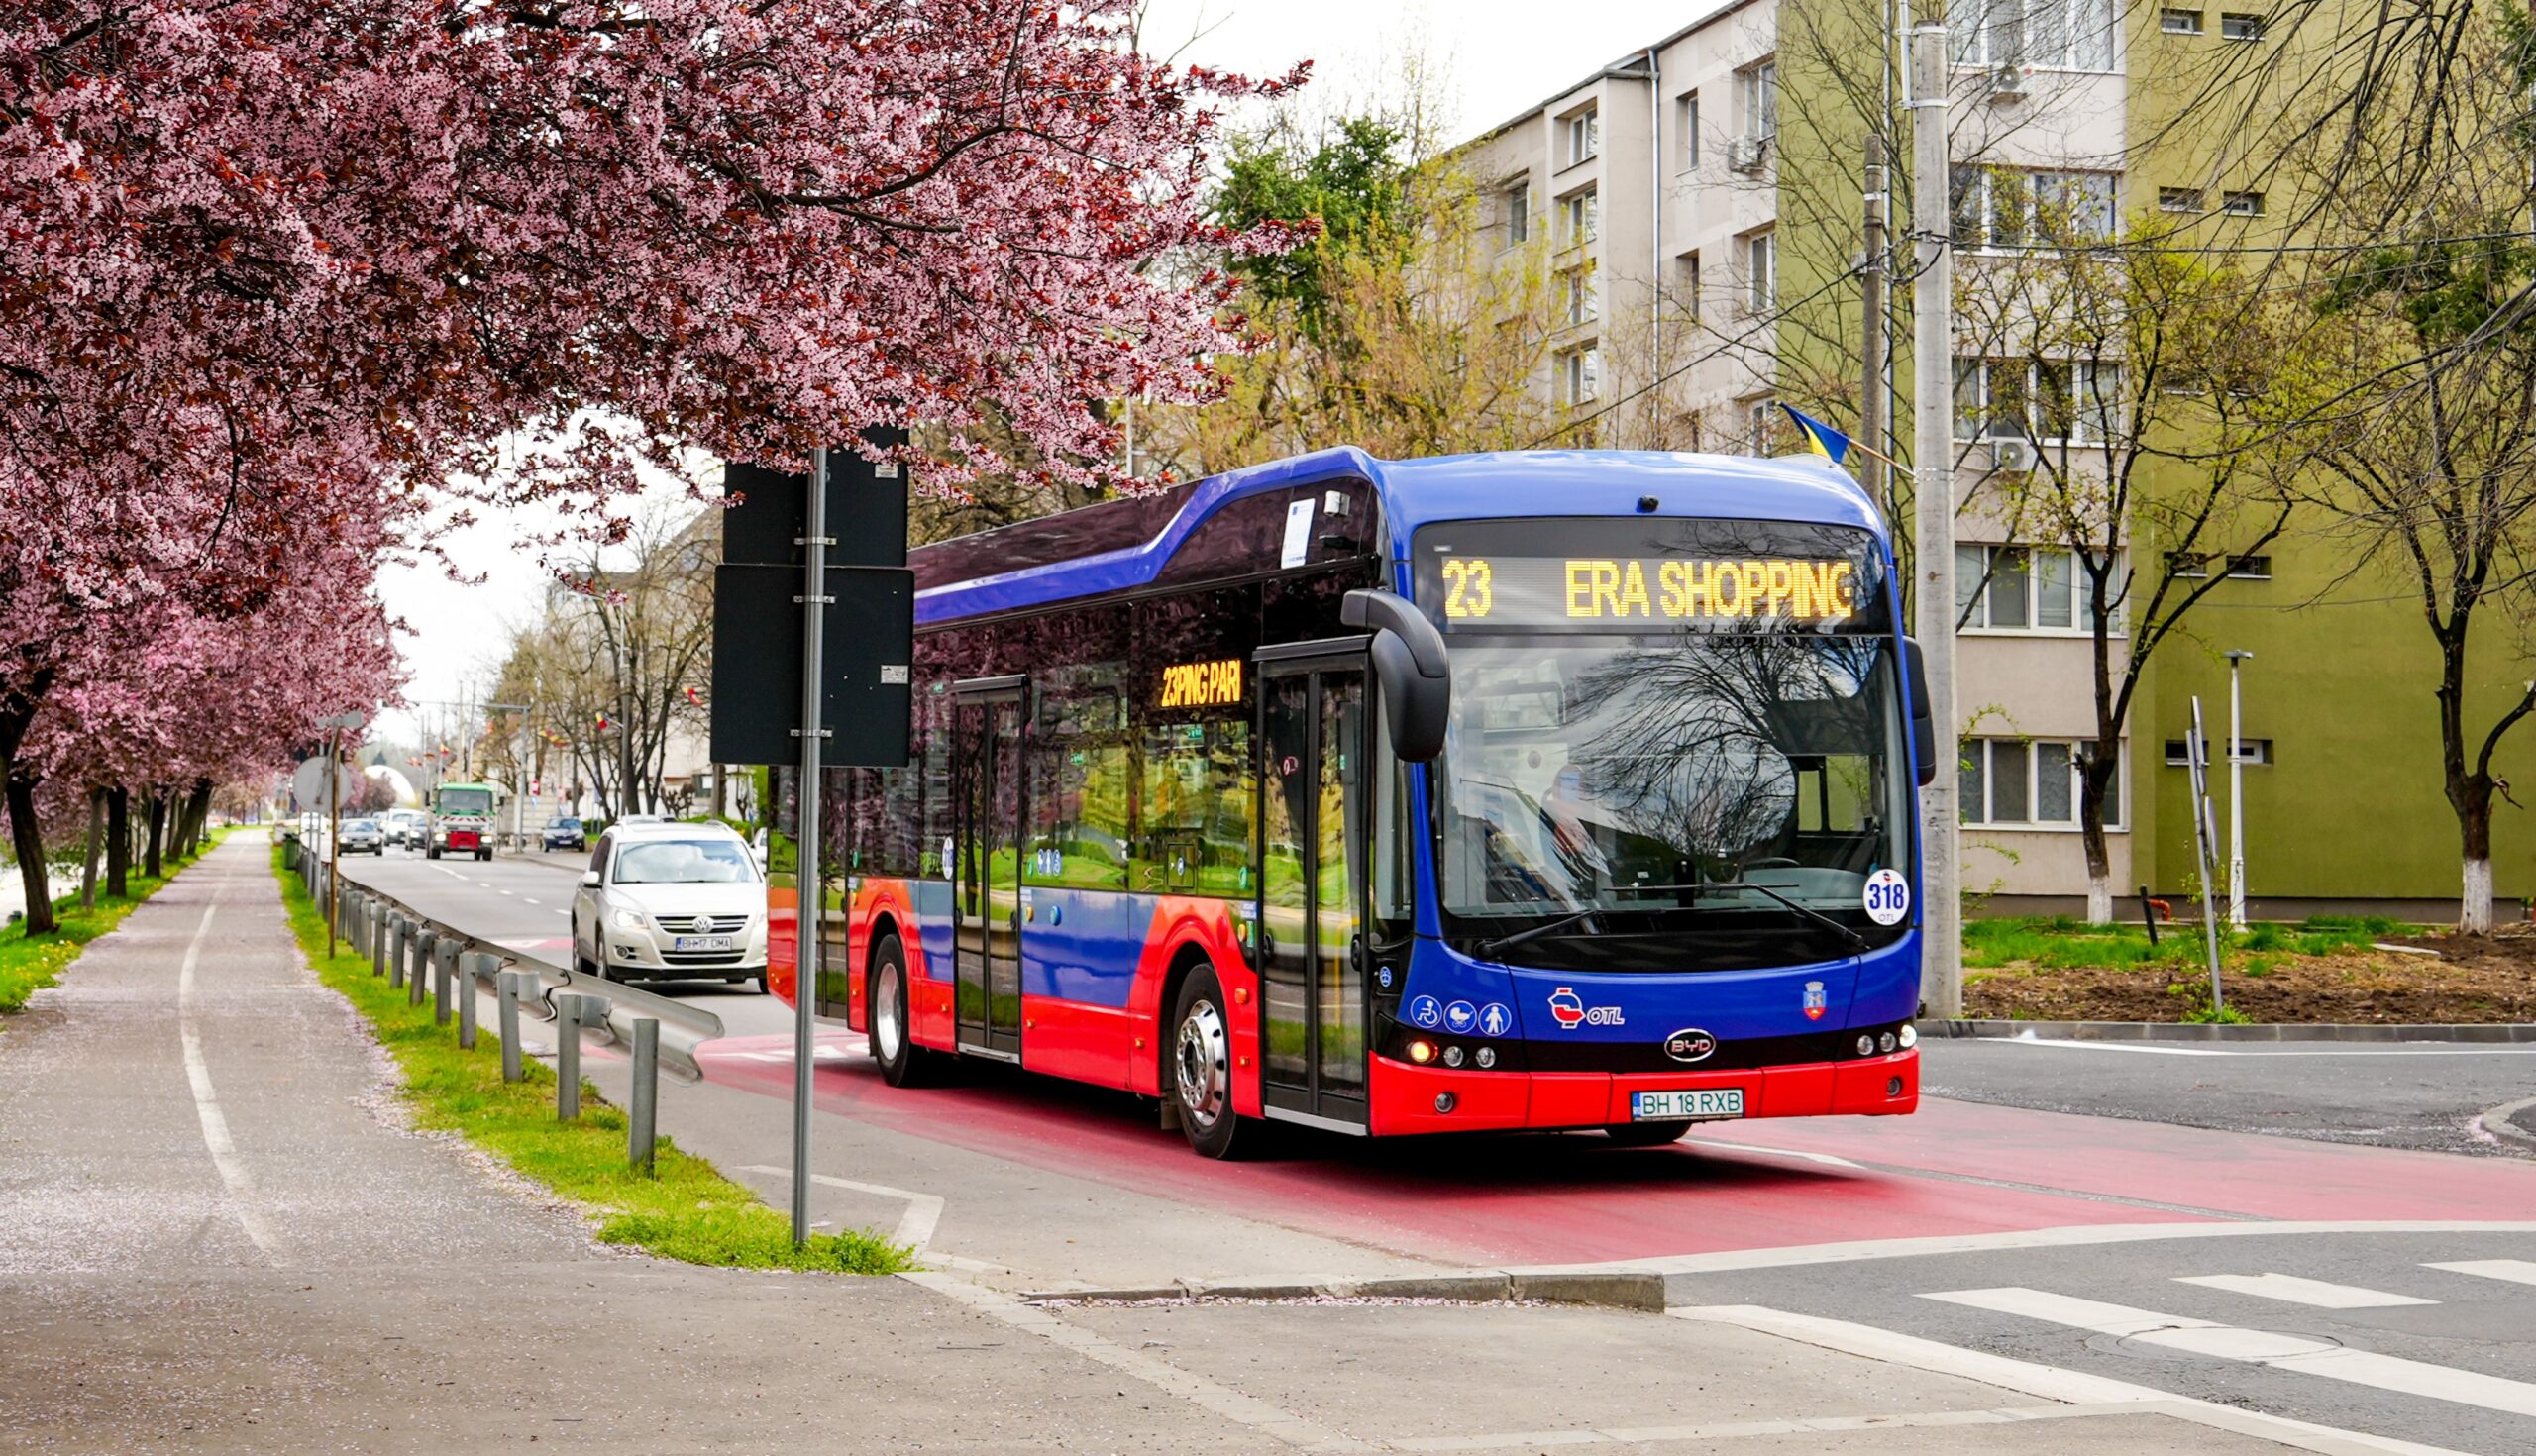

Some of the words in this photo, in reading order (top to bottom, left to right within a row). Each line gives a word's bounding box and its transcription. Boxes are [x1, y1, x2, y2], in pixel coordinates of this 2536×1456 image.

[1442, 560, 1491, 617] 23
[1565, 560, 1650, 617] ERA
[1659, 561, 1852, 617] SHOPPING
[1869, 884, 1904, 909] 318
[1587, 1007, 1625, 1025] OTL
[1671, 1039, 1712, 1053] BYD
[1642, 1094, 1670, 1115] BH
[1678, 1093, 1695, 1113] 18
[1701, 1092, 1741, 1112] RXB
